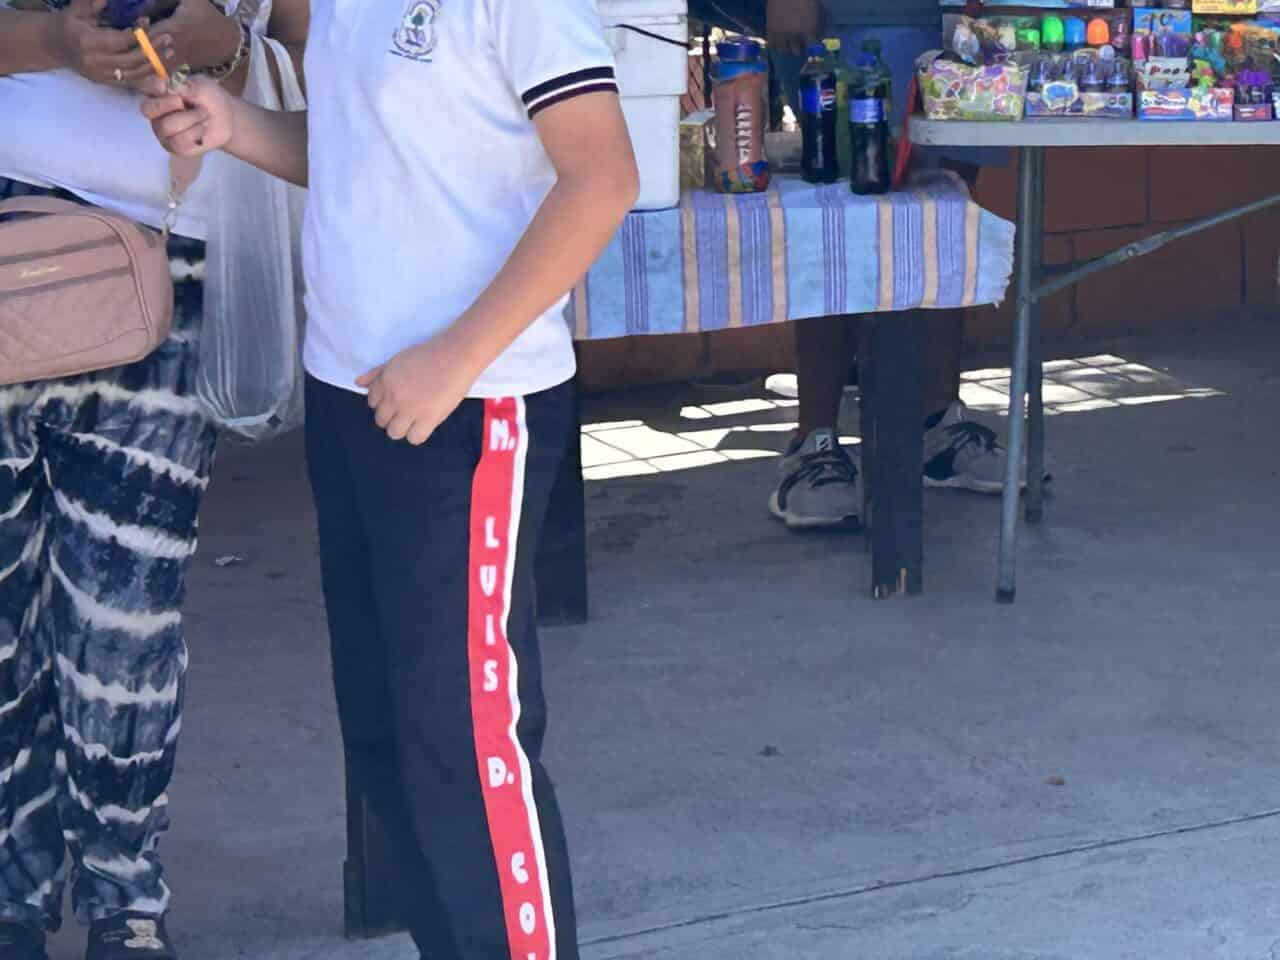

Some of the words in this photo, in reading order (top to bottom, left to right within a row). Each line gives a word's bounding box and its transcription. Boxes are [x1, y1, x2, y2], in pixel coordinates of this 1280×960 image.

[479, 516, 500, 693] LUIS
[487, 756, 515, 788] D.
[511, 851, 538, 960] CO
